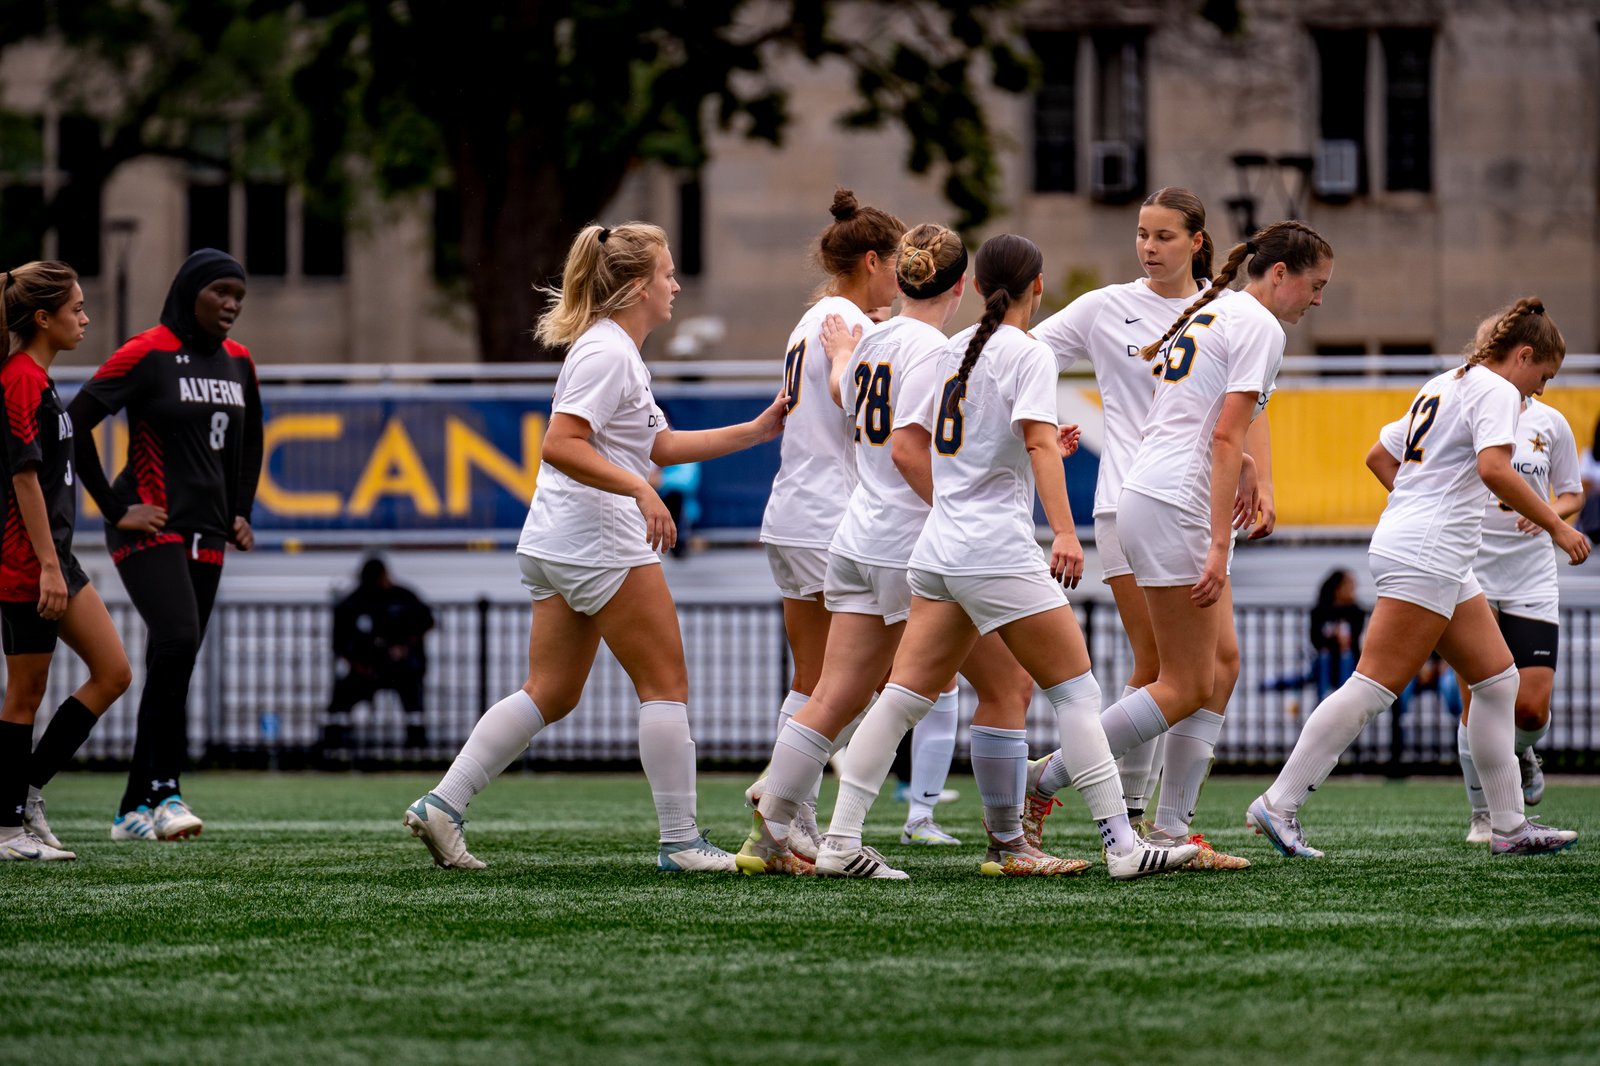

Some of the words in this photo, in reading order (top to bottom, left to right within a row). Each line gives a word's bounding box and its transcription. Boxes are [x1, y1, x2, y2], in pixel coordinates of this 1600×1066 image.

[209, 411, 230, 450] 8
[854, 361, 894, 447] 28
[934, 373, 968, 457] 6
[1403, 393, 1442, 465] 12
